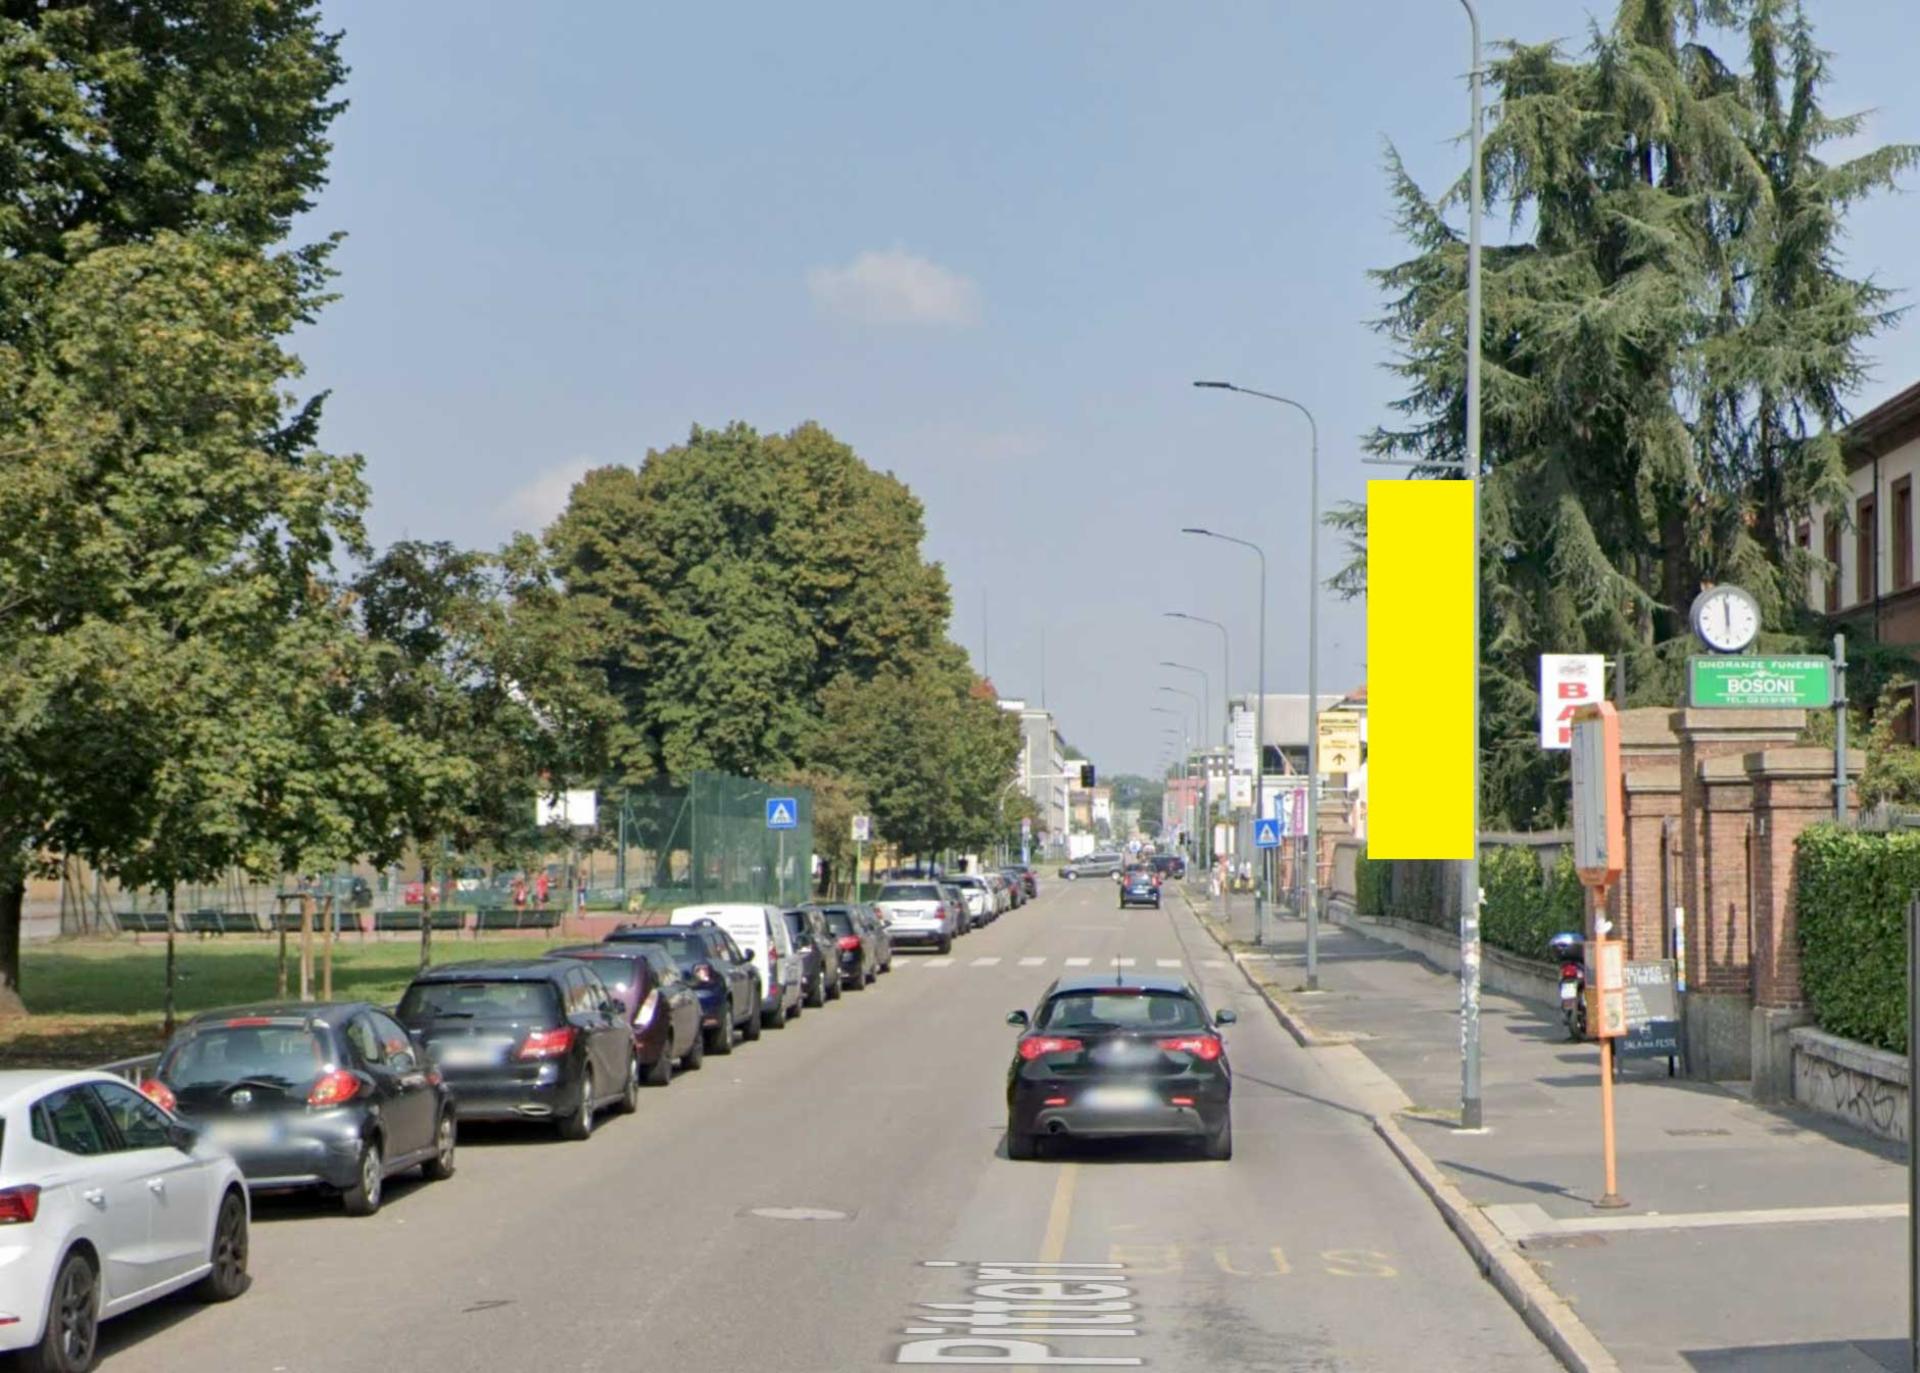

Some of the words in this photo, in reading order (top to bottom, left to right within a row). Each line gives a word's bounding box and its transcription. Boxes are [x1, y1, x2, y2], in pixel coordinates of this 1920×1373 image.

[1698, 660, 1765, 669] ONORANZE
[1771, 660, 1824, 669] FUNEBRI
[1727, 679, 1795, 693] BOSONI
[1108, 1243, 1398, 1277] BUS
